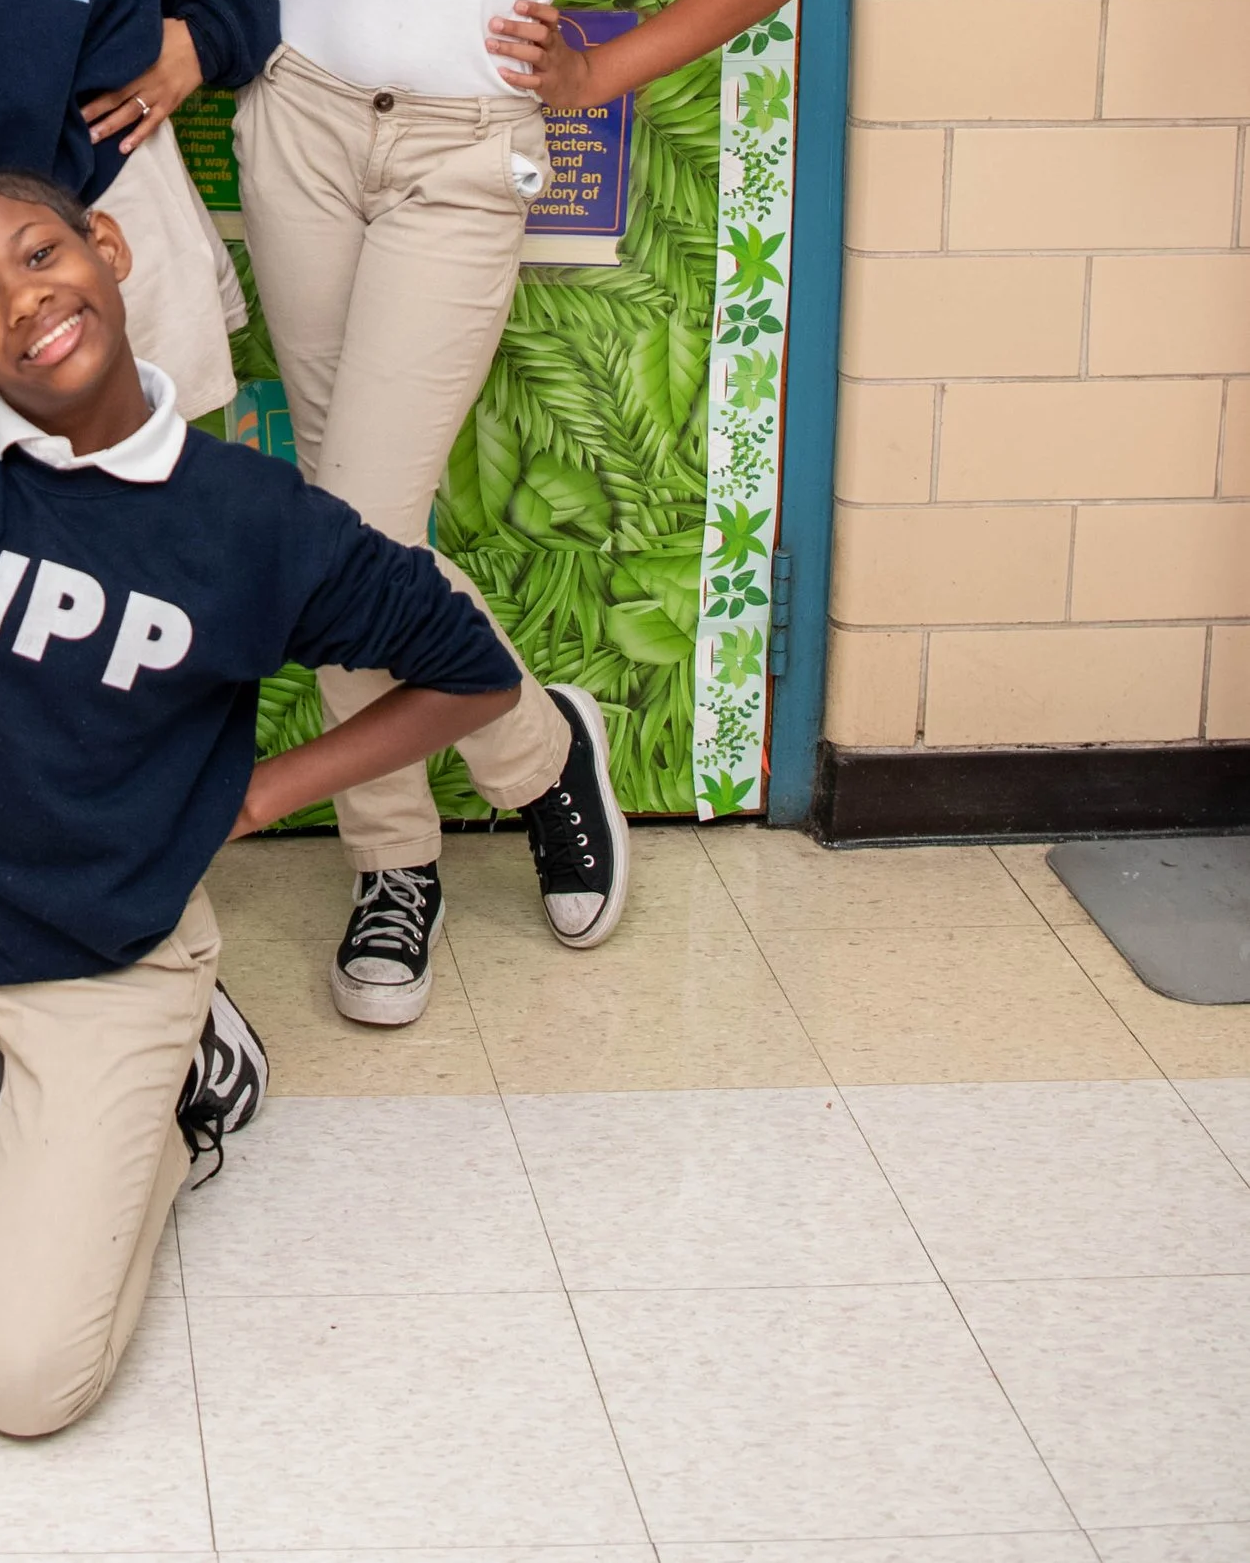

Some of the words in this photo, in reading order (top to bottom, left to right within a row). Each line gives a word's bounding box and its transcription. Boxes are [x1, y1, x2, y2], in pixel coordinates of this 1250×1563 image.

[587, 107, 608, 119] on
[544, 120, 592, 137] opics.
[544, 138, 607, 155] racters,
[552, 154, 583, 167] and
[580, 172, 602, 184] an
[581, 186, 600, 200] of
[530, 203, 589, 216] events.
